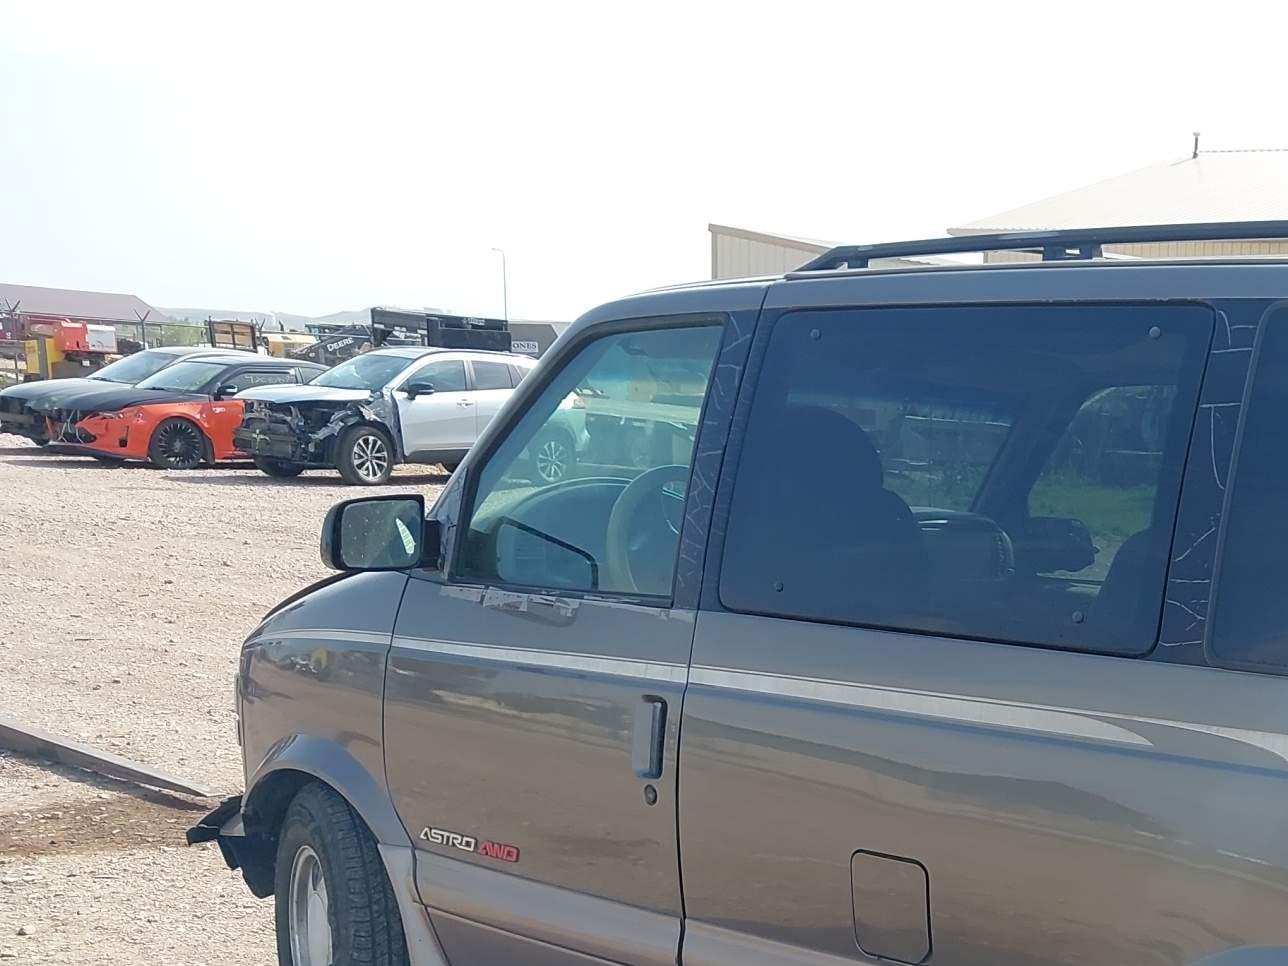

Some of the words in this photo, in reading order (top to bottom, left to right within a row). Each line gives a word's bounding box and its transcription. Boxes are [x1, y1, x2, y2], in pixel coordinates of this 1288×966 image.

[327, 337, 354, 351] DEERE
[420, 827, 476, 852] ASTRO
[479, 841, 518, 862] AWD
